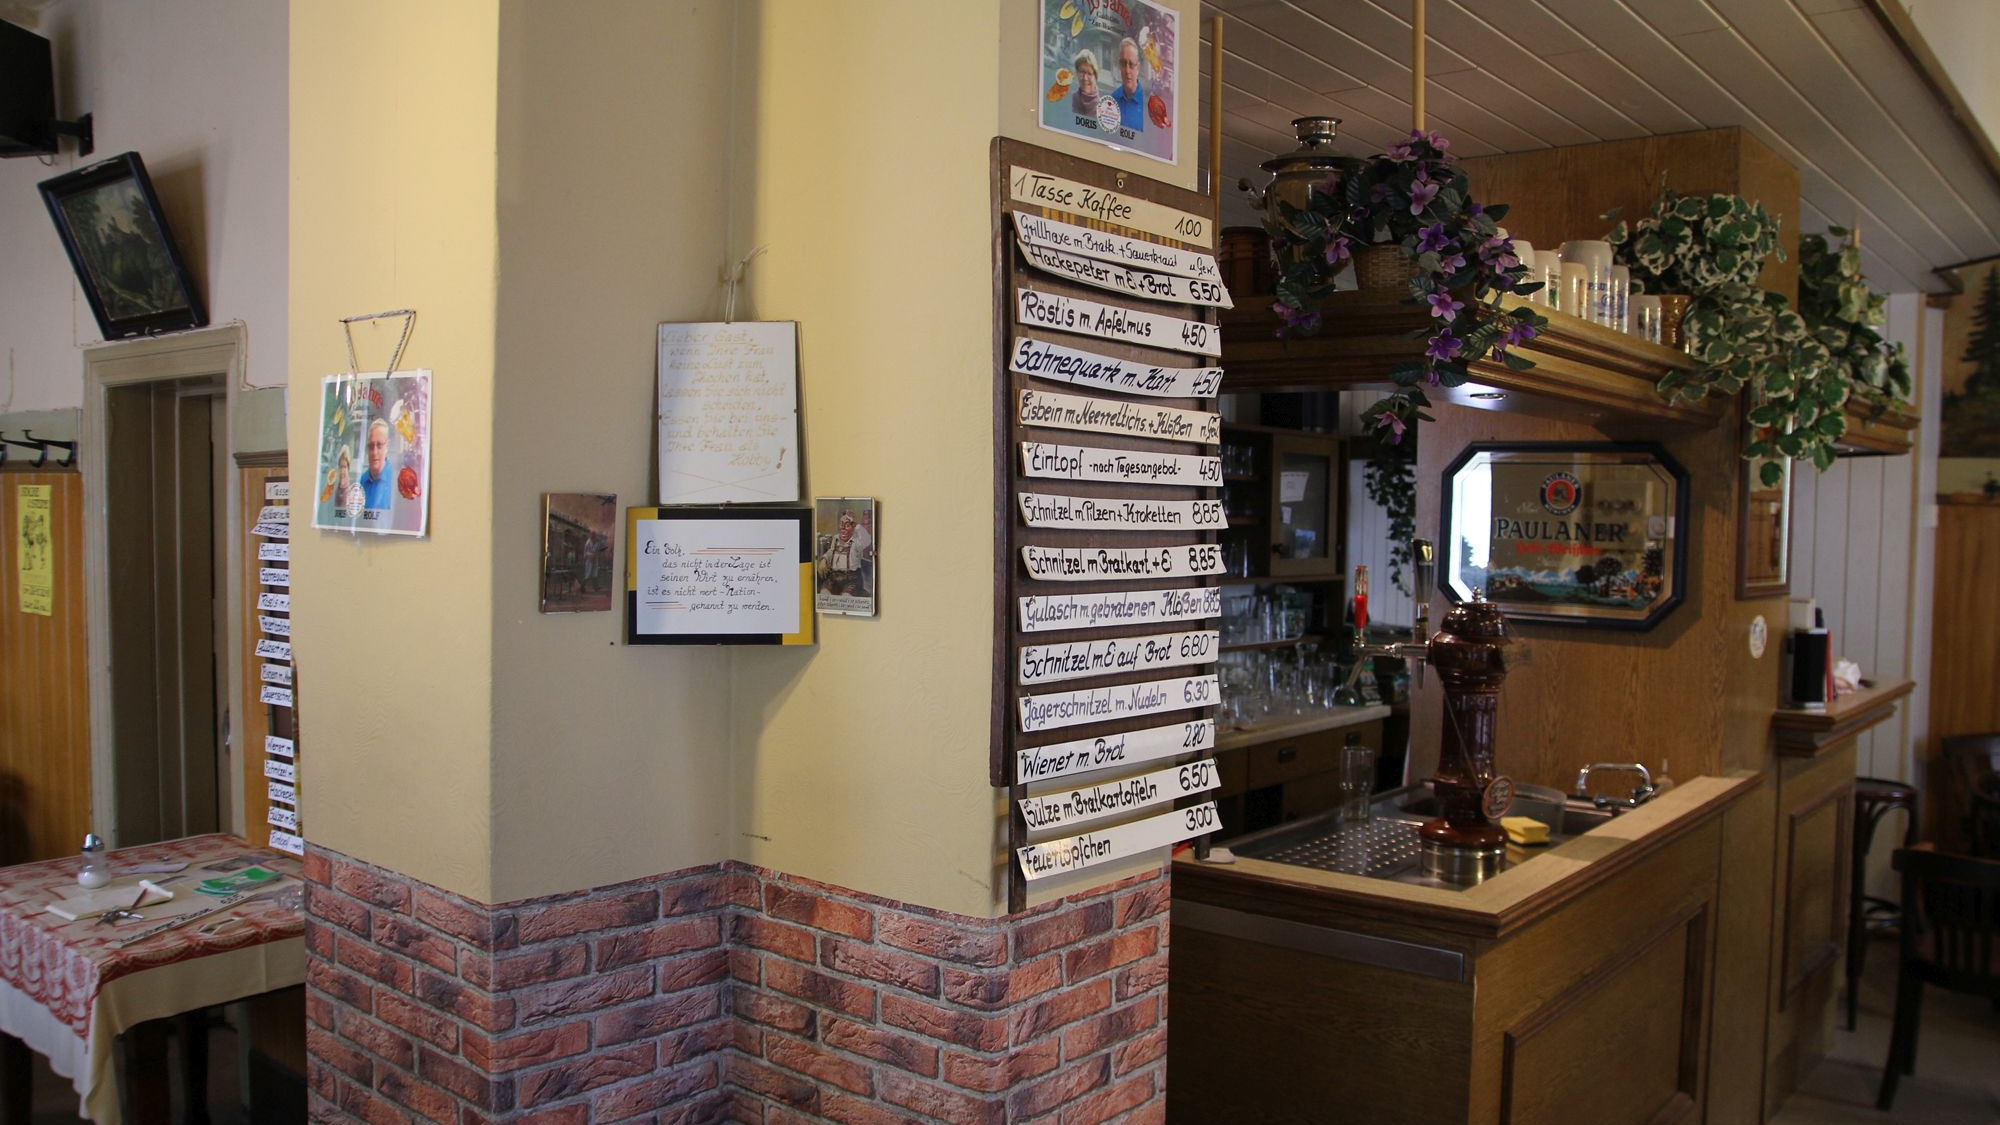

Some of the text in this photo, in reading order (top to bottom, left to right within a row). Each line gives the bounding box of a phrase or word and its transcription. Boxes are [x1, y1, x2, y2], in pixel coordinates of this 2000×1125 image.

[1075, 116, 1097, 130] DORIS
[1015, 172, 1028, 197] 1
[1031, 174, 1073, 205] Tasse
[1077, 189, 1132, 220] Kaffee
[1020, 214, 1072, 247] Grillhaxe
[1028, 244, 1111, 282] Hackepeter
[1094, 307, 1152, 337] Apfelmus
[1015, 340, 1121, 383] Sahnequark
[1020, 391, 1063, 423] Eisbein
[1030, 443, 1085, 478] Eintopf
[1024, 496, 1073, 522] Schnitzel
[1494, 517, 1628, 543] PAULANER
[1029, 548, 1085, 576] Schnitzel
[1025, 596, 1078, 630] Gulasch
[1090, 592, 1156, 625] gebratenen
[1023, 643, 1091, 679] Schnitzel
[1117, 642, 1142, 671] auf
[1144, 637, 1173, 663] Brot
[1024, 688, 1112, 730] Jägerschnitzel
[1128, 684, 1167, 711] Nudeln
[1021, 746, 1075, 778] Wiener
[1094, 735, 1126, 765] Brot
[1023, 799, 1061, 828] Sülze
[1072, 777, 1158, 816] Bratkartoffeln
